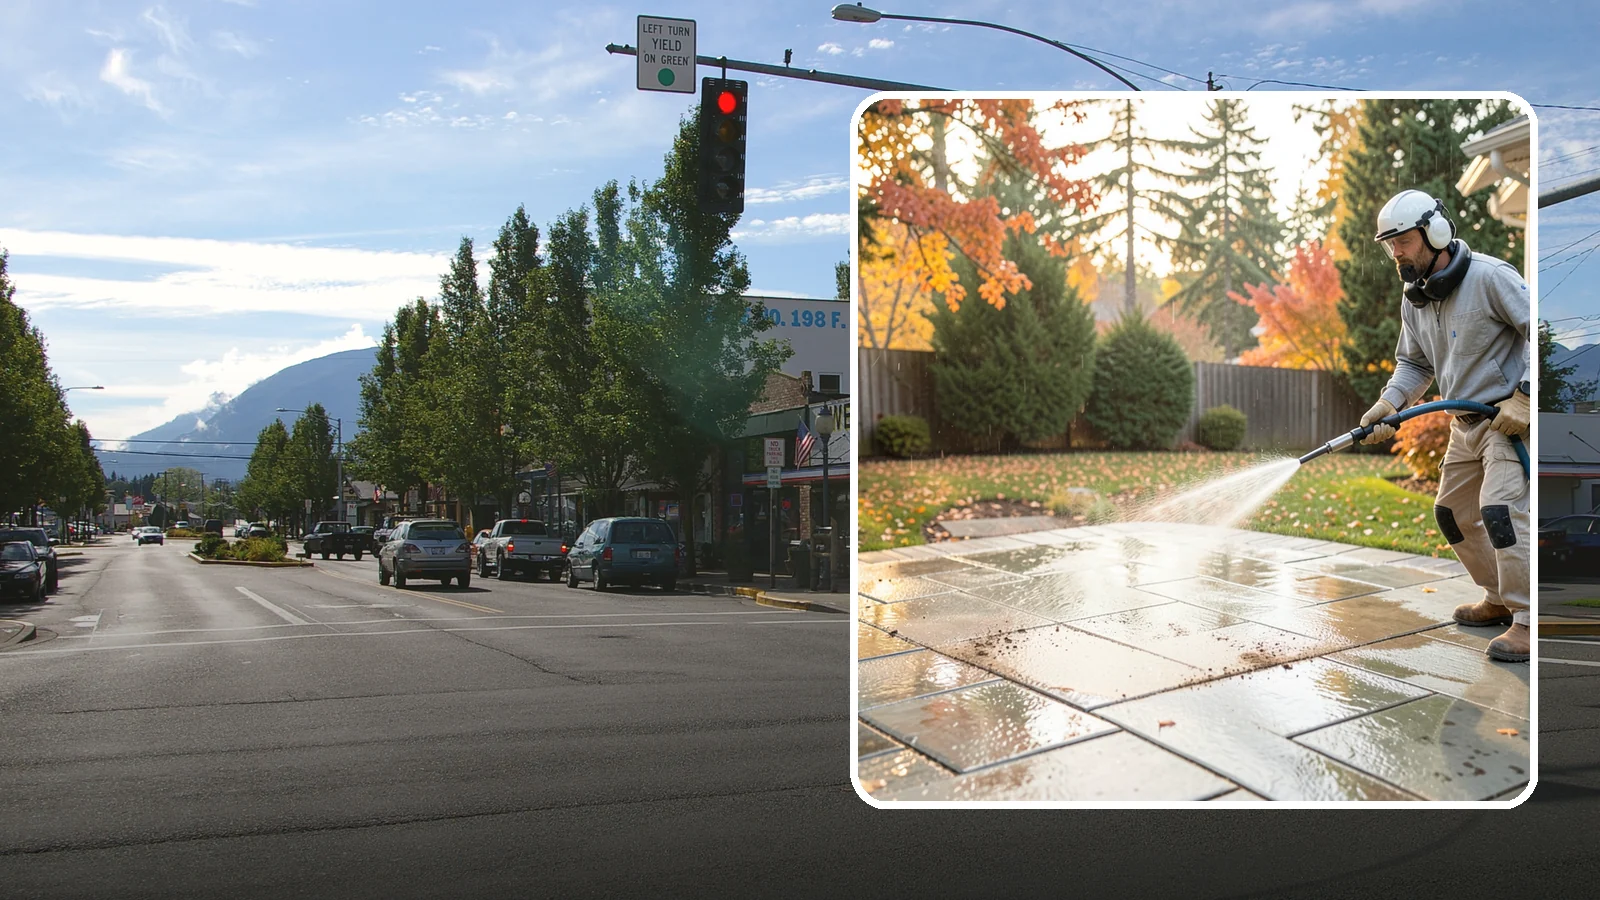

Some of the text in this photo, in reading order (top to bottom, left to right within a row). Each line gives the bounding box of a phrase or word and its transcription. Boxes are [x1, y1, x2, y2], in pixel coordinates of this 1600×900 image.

[643, 24, 690, 36] LEFT TURN
[652, 37, 682, 51] YIELD
[791, 309, 826, 328] 198
[831, 312, 847, 329] F.
